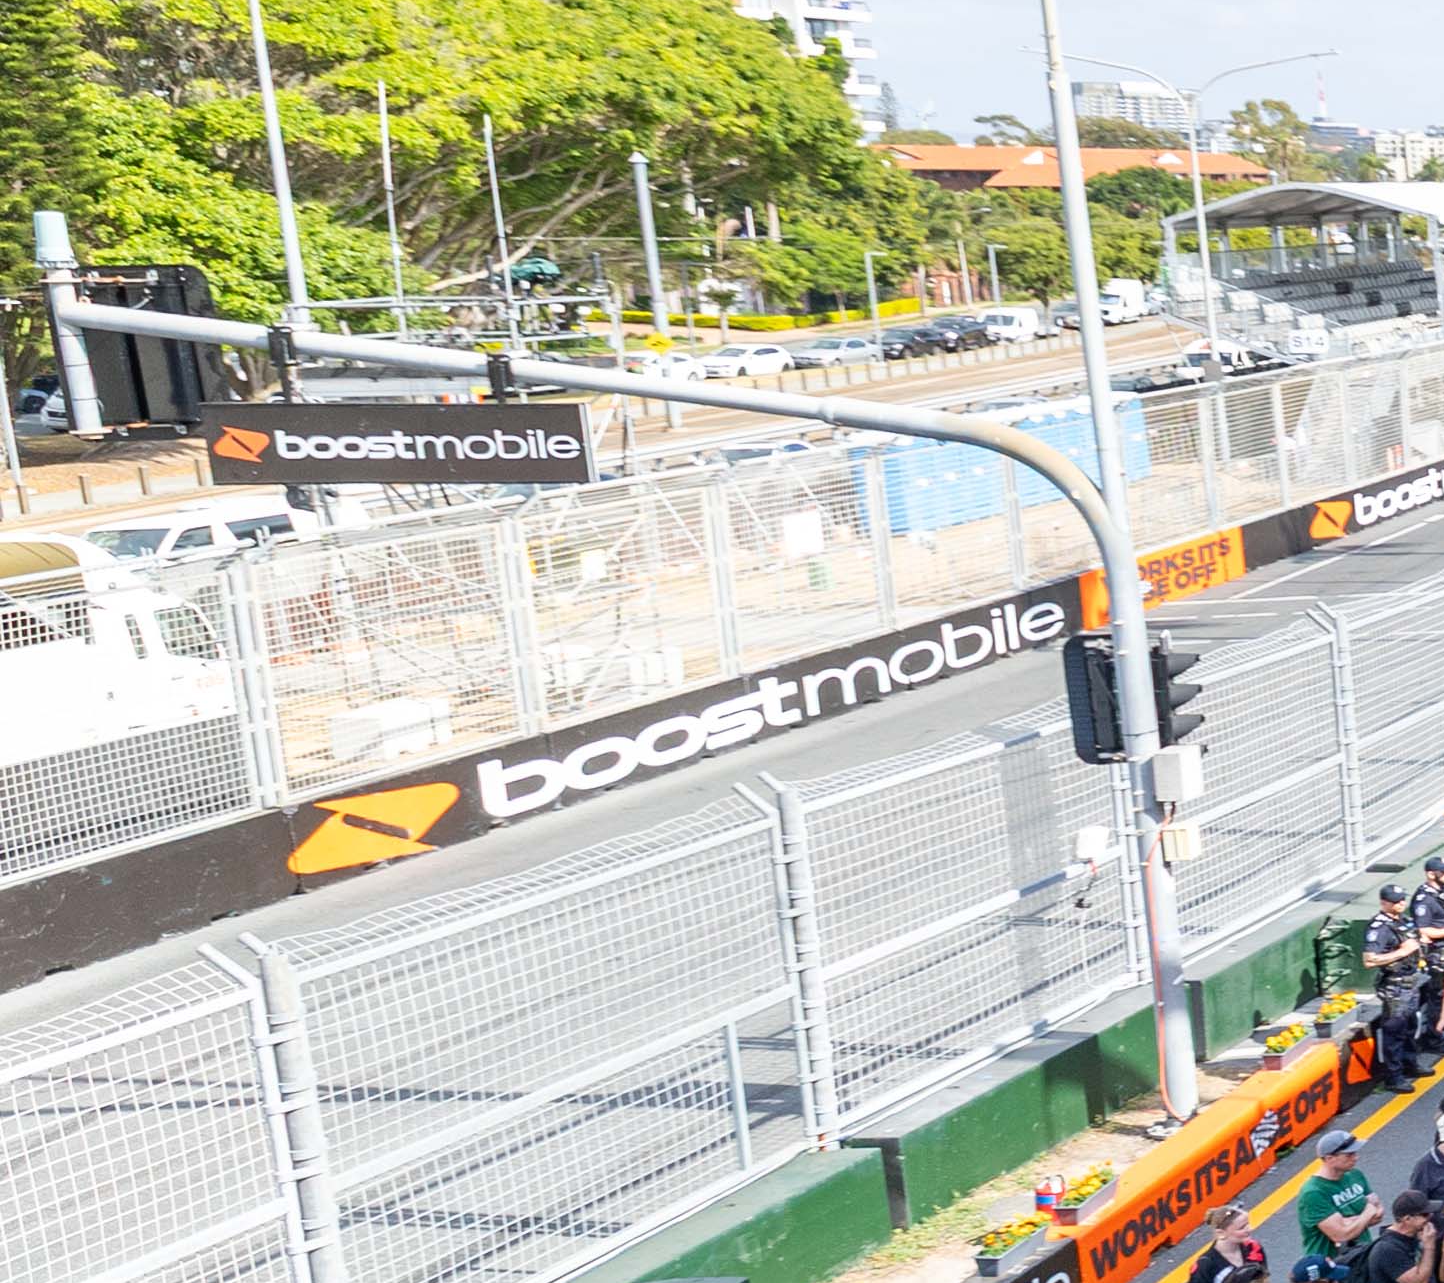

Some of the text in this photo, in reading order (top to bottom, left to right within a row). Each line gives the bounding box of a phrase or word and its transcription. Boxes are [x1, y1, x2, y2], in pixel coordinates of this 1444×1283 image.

[1291, 332, 1326, 349] S14
[274, 428, 582, 462] boostmobile
[1137, 537, 1231, 581] ORKS ITS
[1174, 562, 1217, 589] OFF
[476, 600, 1067, 818] boostmobile
[1090, 1071, 1334, 1280] WORKS ITS AE OFF
